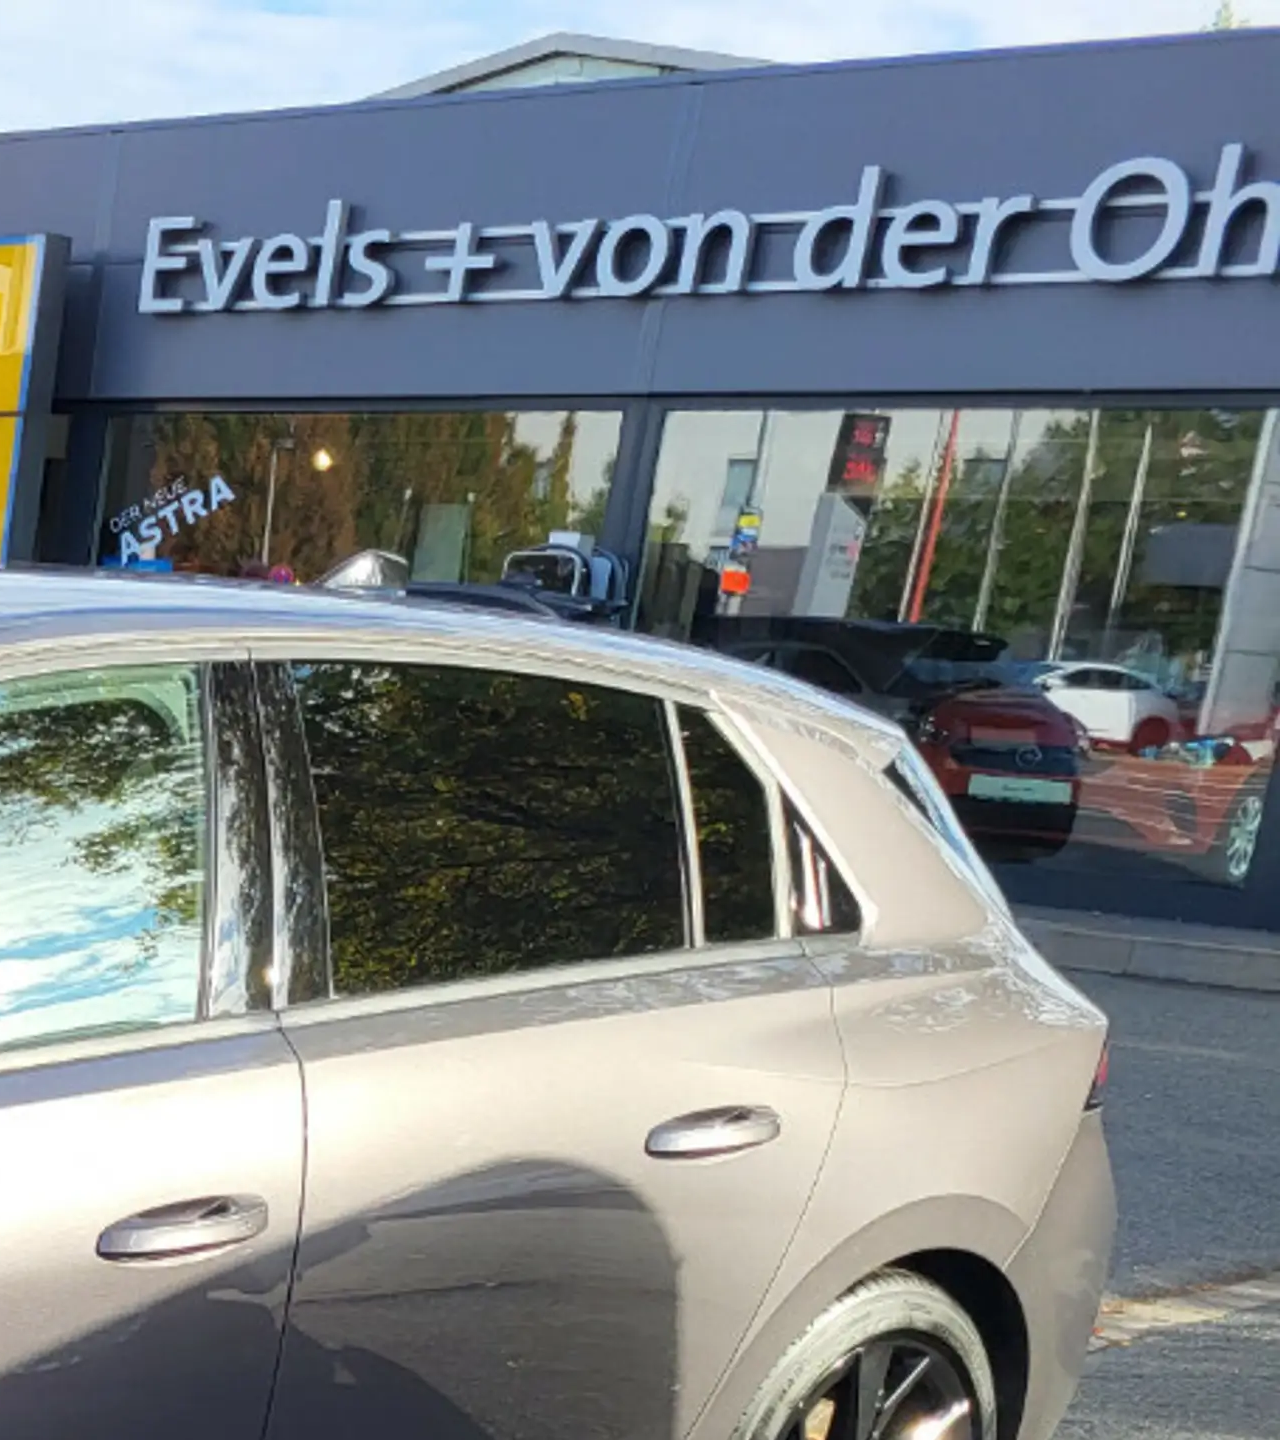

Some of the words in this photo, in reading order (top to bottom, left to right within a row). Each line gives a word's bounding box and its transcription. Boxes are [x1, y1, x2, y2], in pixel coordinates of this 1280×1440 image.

[530, 207, 751, 299] von
[792, 164, 1034, 289] der
[110, 503, 142, 534] DER
[120, 474, 237, 568] ASTRA
